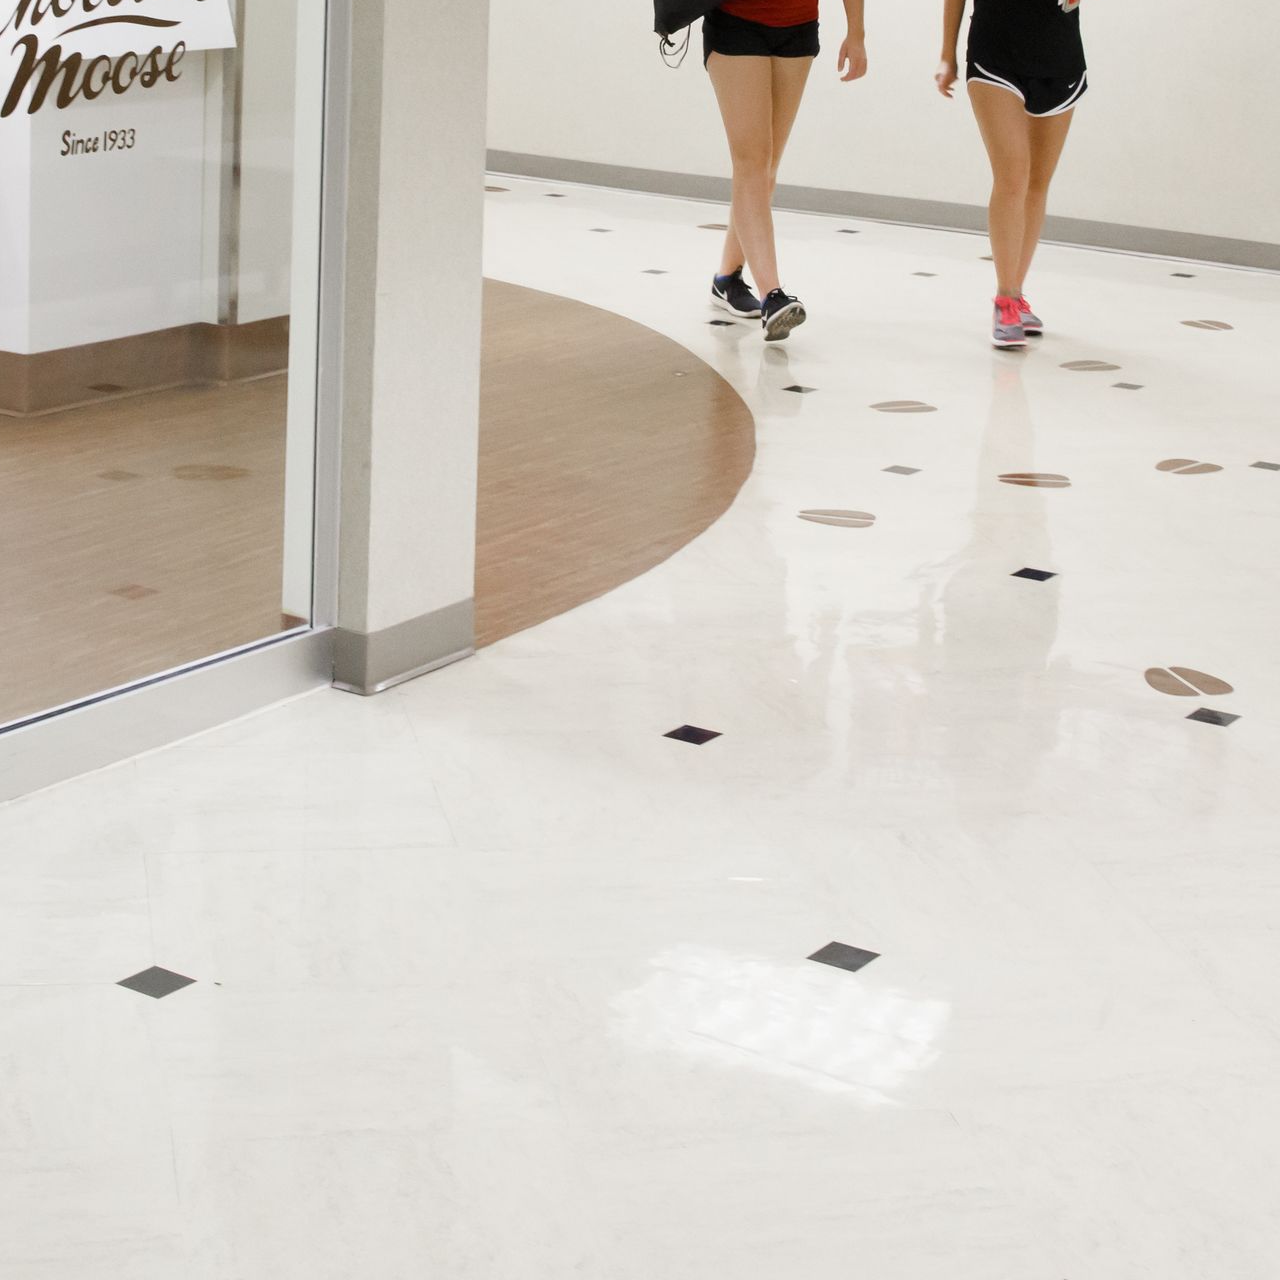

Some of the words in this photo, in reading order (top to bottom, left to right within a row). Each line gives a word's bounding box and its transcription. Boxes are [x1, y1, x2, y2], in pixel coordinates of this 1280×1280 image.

[1, 35, 186, 118] Moose
[61, 129, 99, 157] Since
[102, 128, 137, 153] 1933
